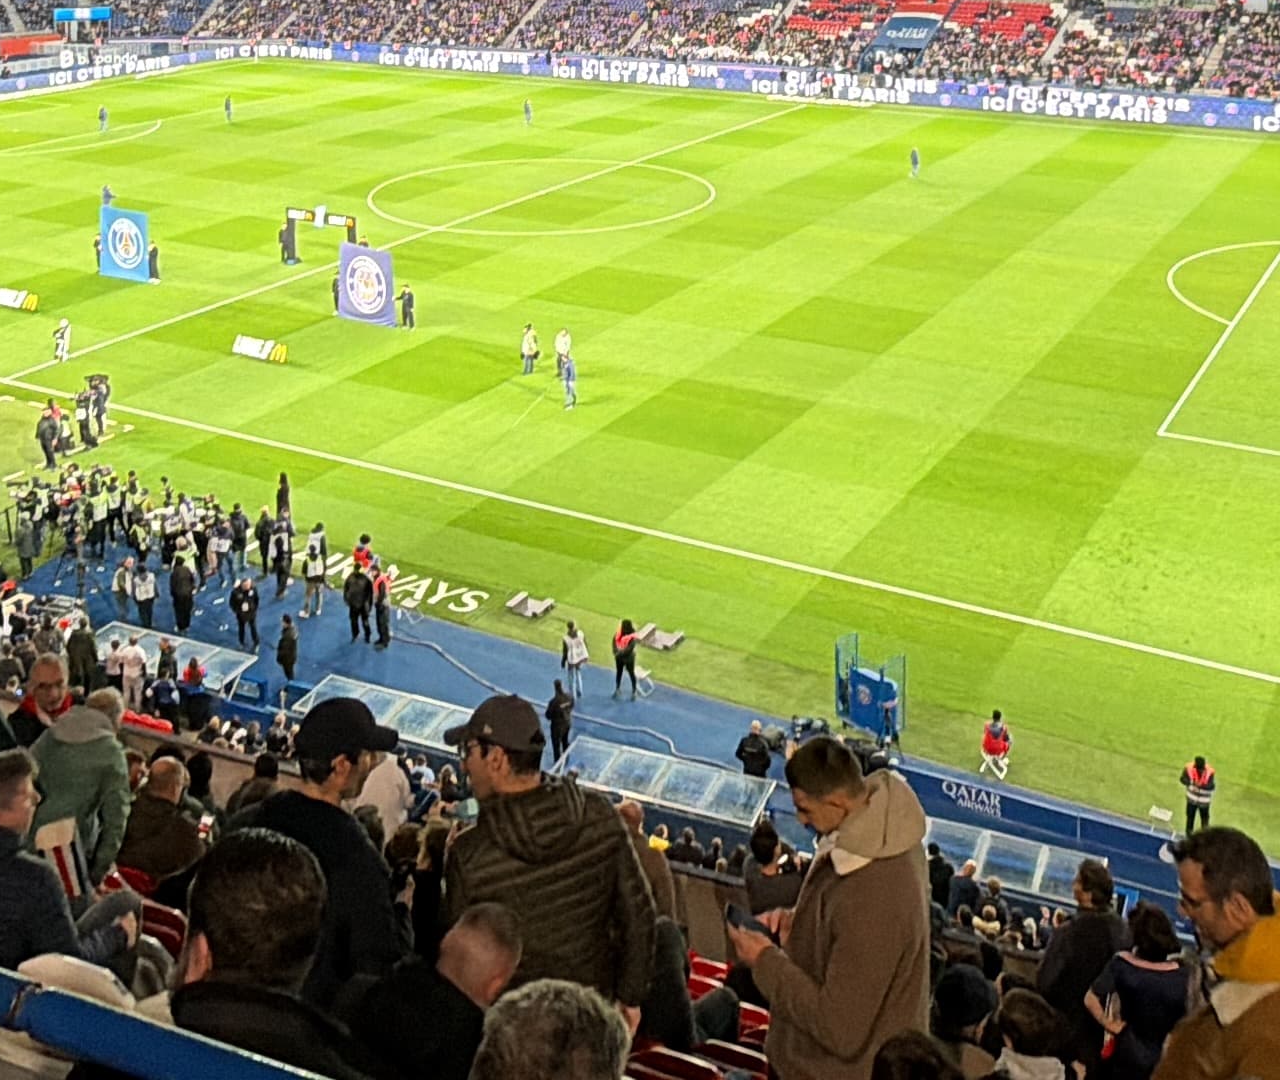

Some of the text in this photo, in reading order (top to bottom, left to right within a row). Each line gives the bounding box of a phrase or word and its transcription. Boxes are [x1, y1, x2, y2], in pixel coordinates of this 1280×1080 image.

[216, 48, 234, 60] ICI
[291, 47, 332, 61] PARIS
[452, 58, 499, 73] PARIS
[48, 55, 170, 87] ICI C'EST PARIS
[752, 79, 778, 94] ICI
[848, 86, 910, 104] PARIS
[983, 96, 1168, 124] ICI C'EST PARIS
[942, 780, 1001, 808] QATAR
